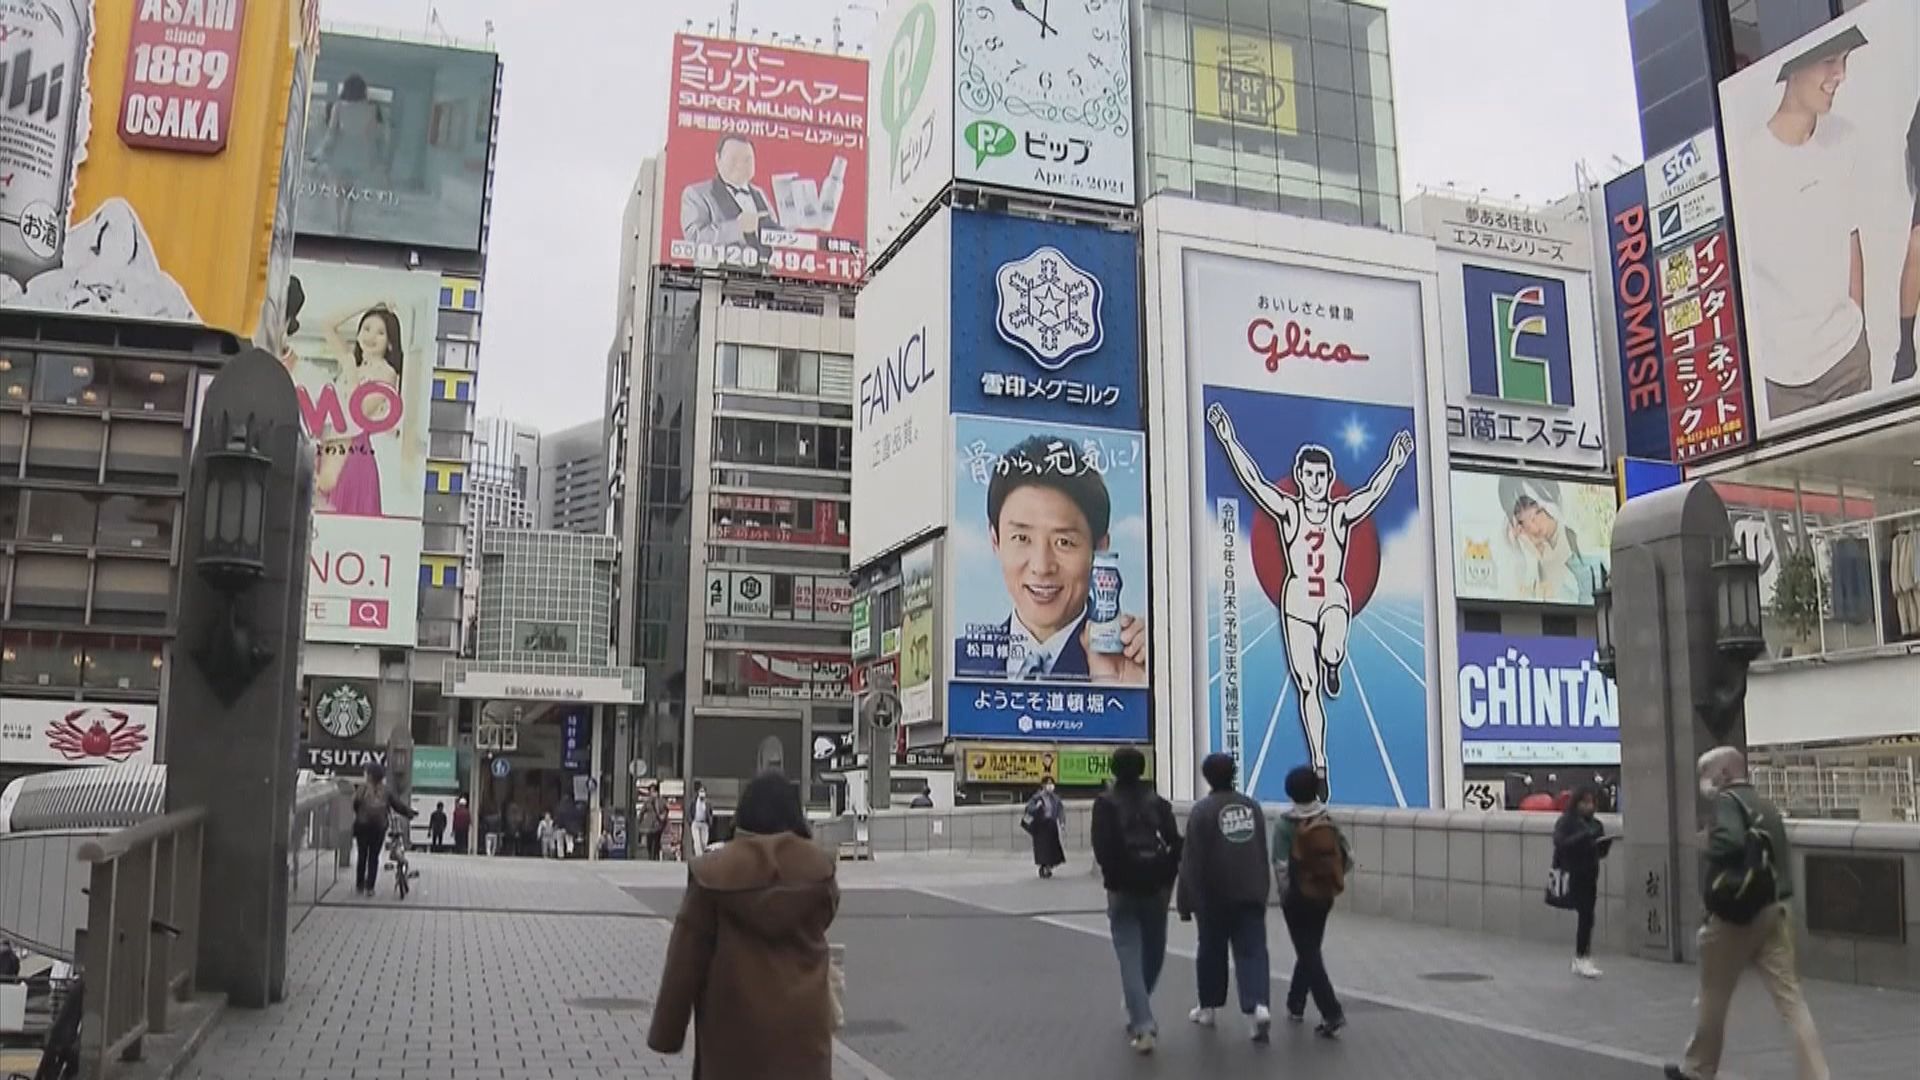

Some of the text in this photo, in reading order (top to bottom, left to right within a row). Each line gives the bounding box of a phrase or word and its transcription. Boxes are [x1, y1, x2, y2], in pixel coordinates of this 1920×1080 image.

[140, 0, 235, 31] ASAHI
[165, 27, 206, 46] since
[681, 38, 784, 71] スーパー
[134, 44, 229, 90] 1889
[679, 63, 865, 105] ミリオンヘアー
[125, 93, 219, 142] OSAKA
[678, 90, 864, 128] SUPER MILLION HAIR
[1025, 130, 1093, 166] ピップ
[22, 213, 57, 249] お酒
[1465, 206, 1548, 234] 夢ある住まい
[1454, 229, 1565, 262] エステムシリーズ
[1257, 295, 1354, 322] おいしさと健康
[1614, 203, 1662, 413] PROMISE
[1247, 318, 1370, 373] Glico
[1697, 234, 1738, 425] インターネット
[859, 326, 935, 433] FANCL
[981, 372, 1121, 406] 雪印メグミルク
[1672, 330, 1704, 435] コミック
[1447, 405, 1603, 451] 日商エステム
[311, 550, 391, 588] NO.1
[1304, 527, 1326, 597] グリコ
[974, 689, 1125, 715] ようこそ道頓堀へ
[308, 748, 387, 768] TSUTAY
